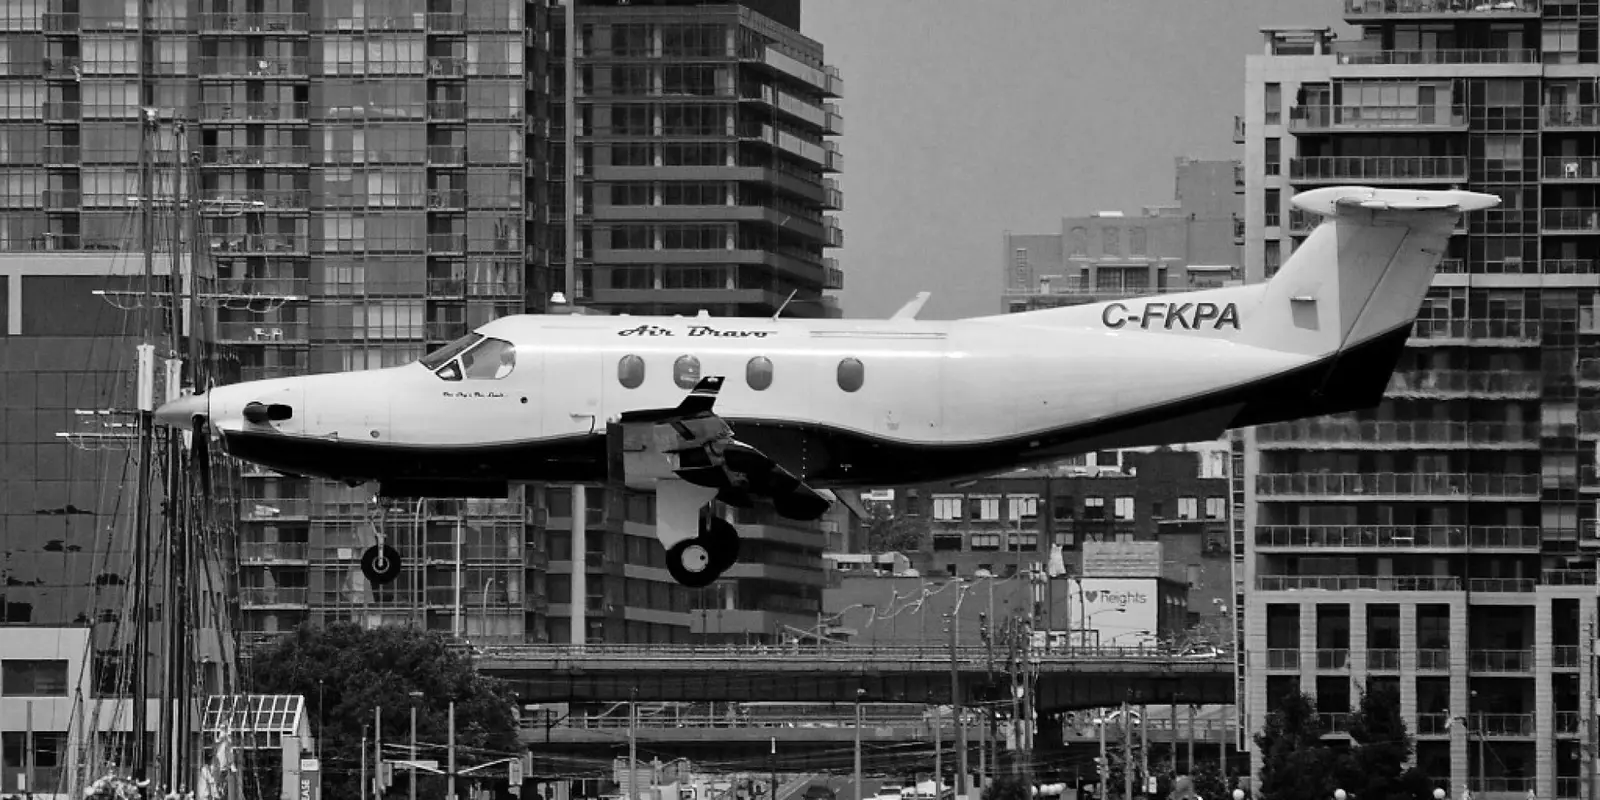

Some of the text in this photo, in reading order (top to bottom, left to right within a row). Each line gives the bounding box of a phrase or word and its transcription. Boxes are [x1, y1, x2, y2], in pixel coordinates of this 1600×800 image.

[1101, 302, 1241, 330] C-FKPA
[617, 324, 778, 338] Air Bravo
